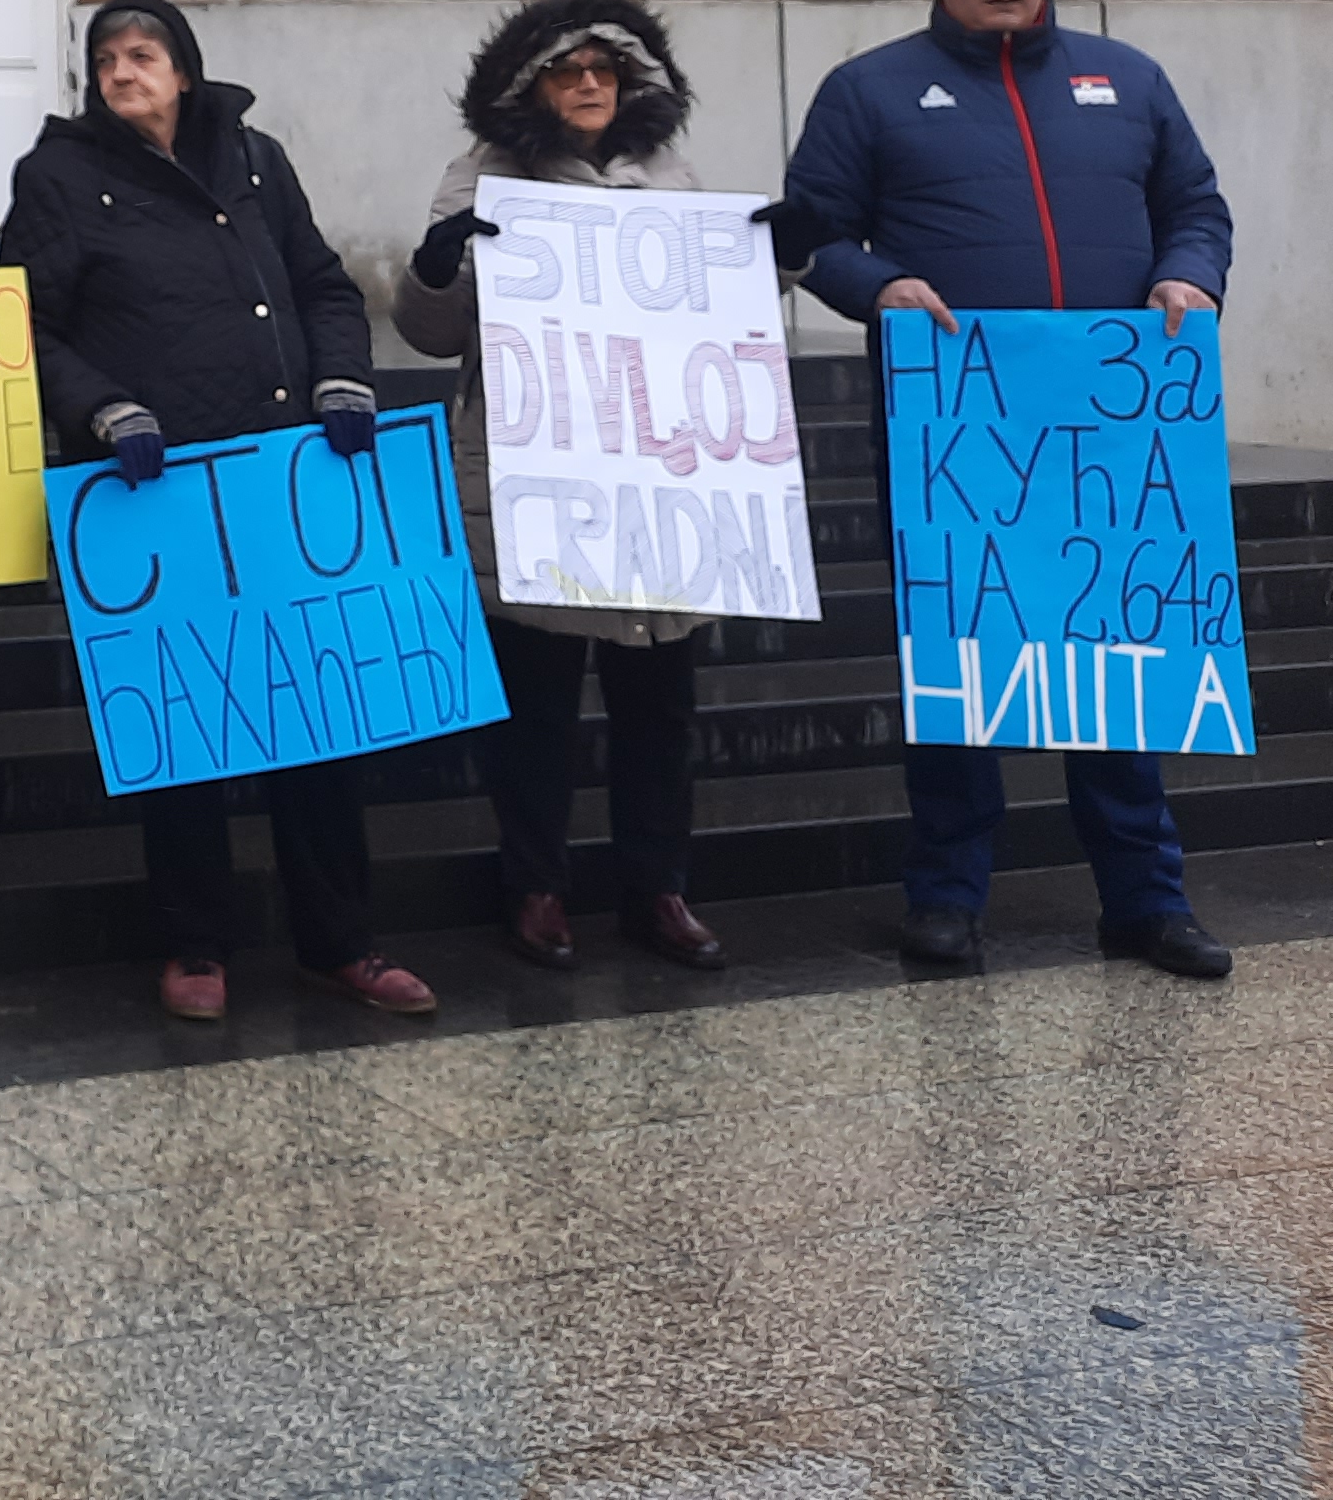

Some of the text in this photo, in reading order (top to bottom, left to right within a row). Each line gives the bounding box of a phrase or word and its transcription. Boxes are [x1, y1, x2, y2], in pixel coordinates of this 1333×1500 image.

[491, 198, 756, 314] STOP
[885, 316, 1008, 419] НА
[69, 415, 454, 615] СТОП
[921, 423, 1187, 533] КУЋА
[897, 527, 1029, 642] НА
[900, 633, 1245, 755] НИШТА
